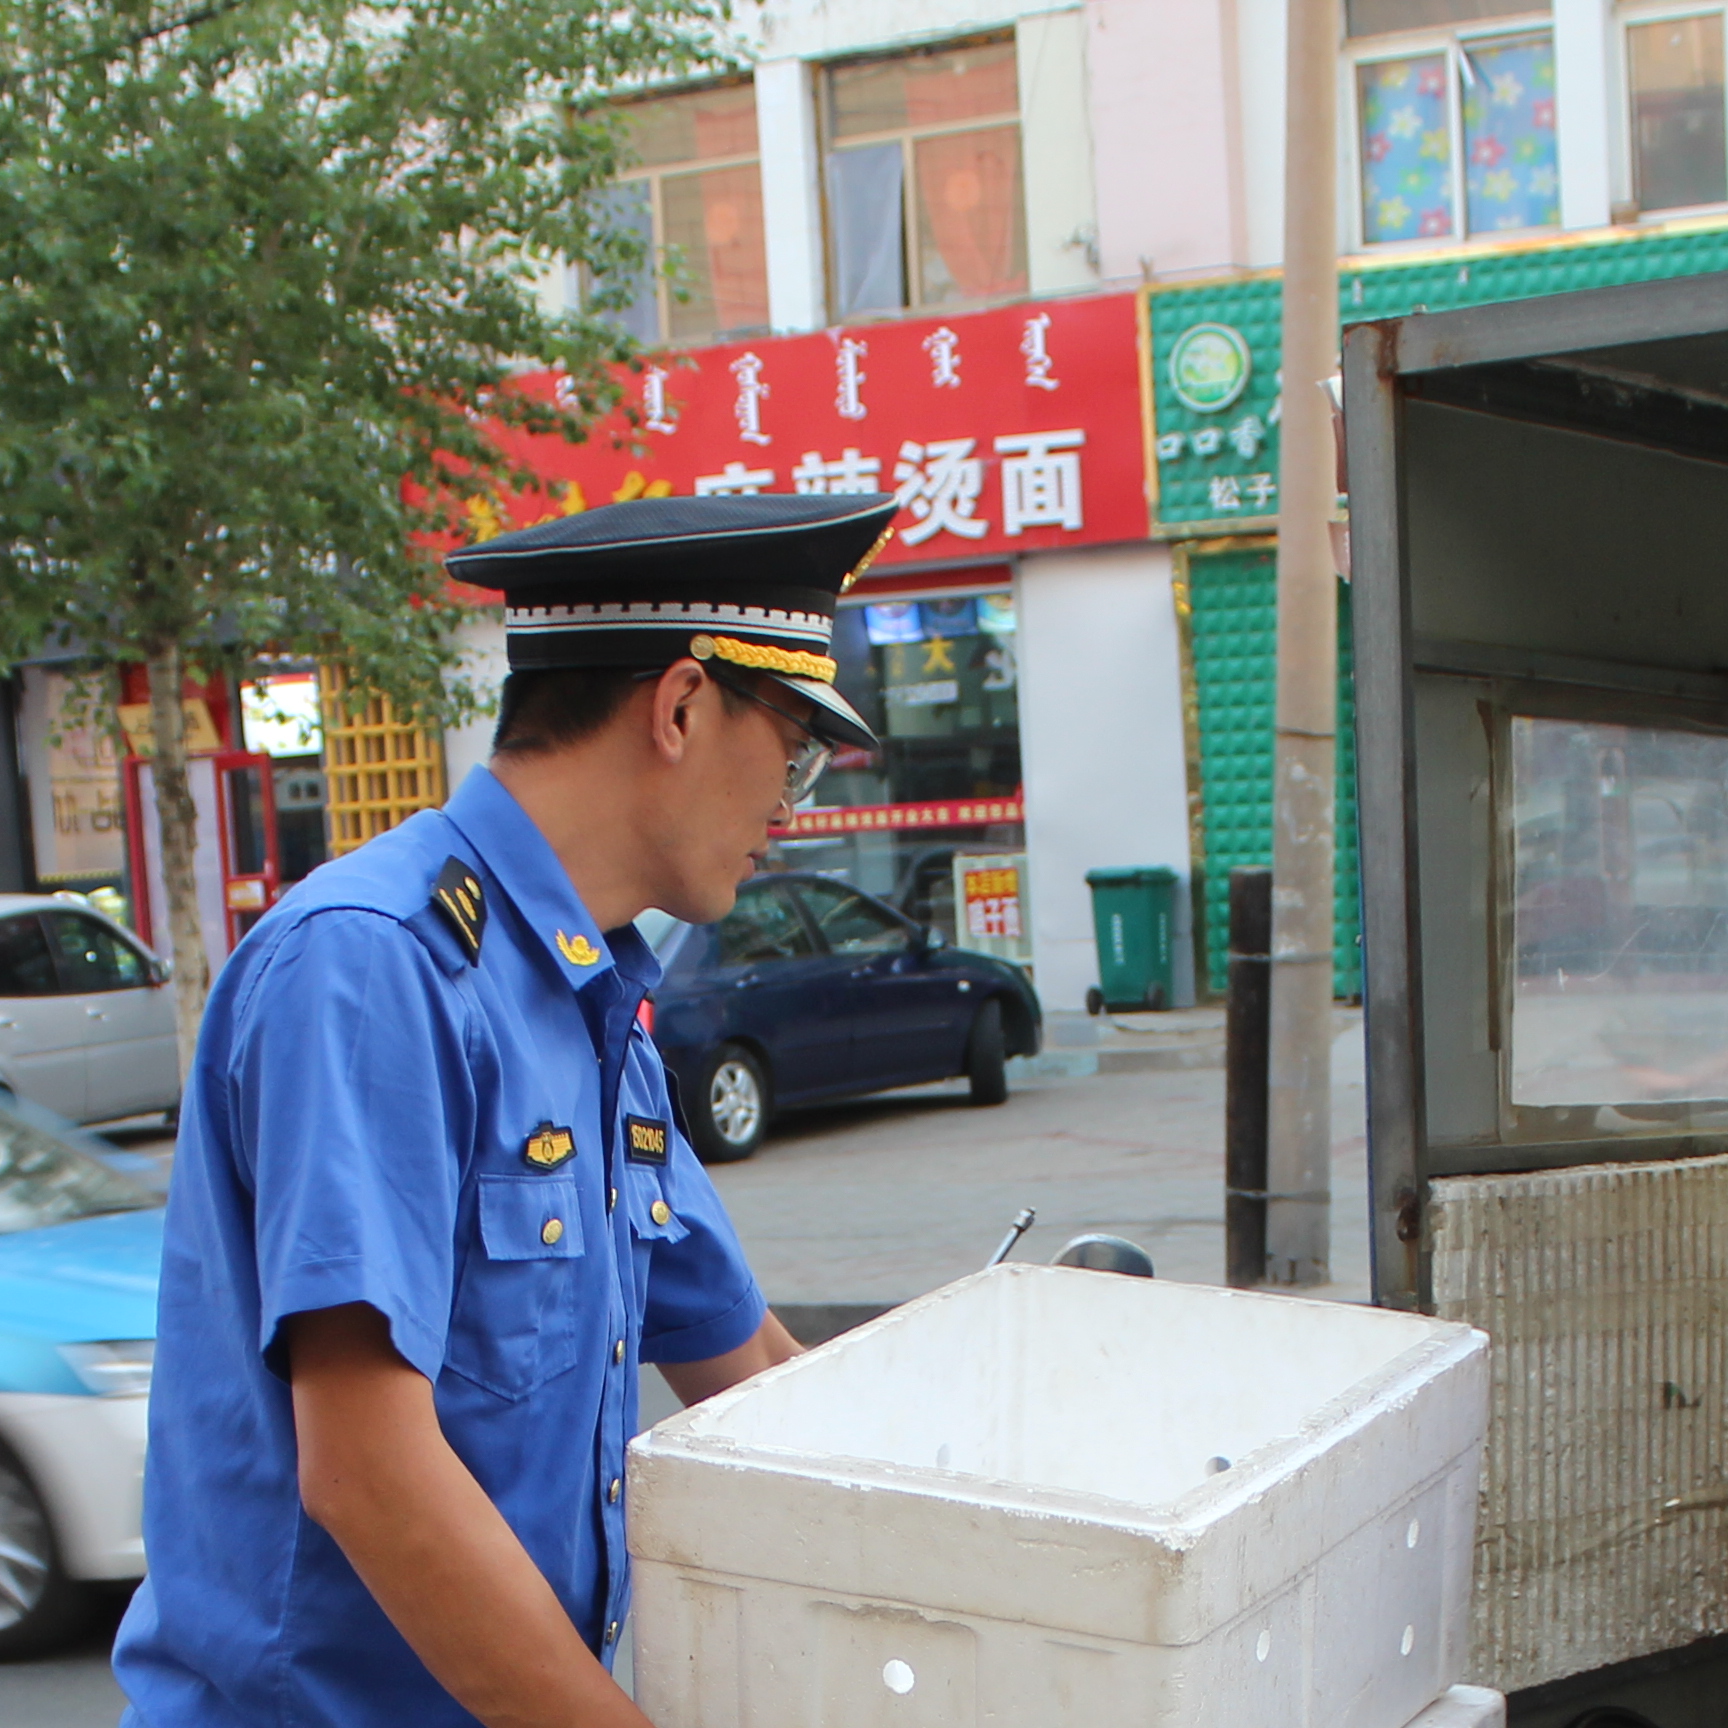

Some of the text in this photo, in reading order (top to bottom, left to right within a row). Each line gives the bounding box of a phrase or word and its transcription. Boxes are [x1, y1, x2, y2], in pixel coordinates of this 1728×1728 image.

[1157, 415, 1264, 460] 口口香
[1209, 473, 1276, 511] 松子
